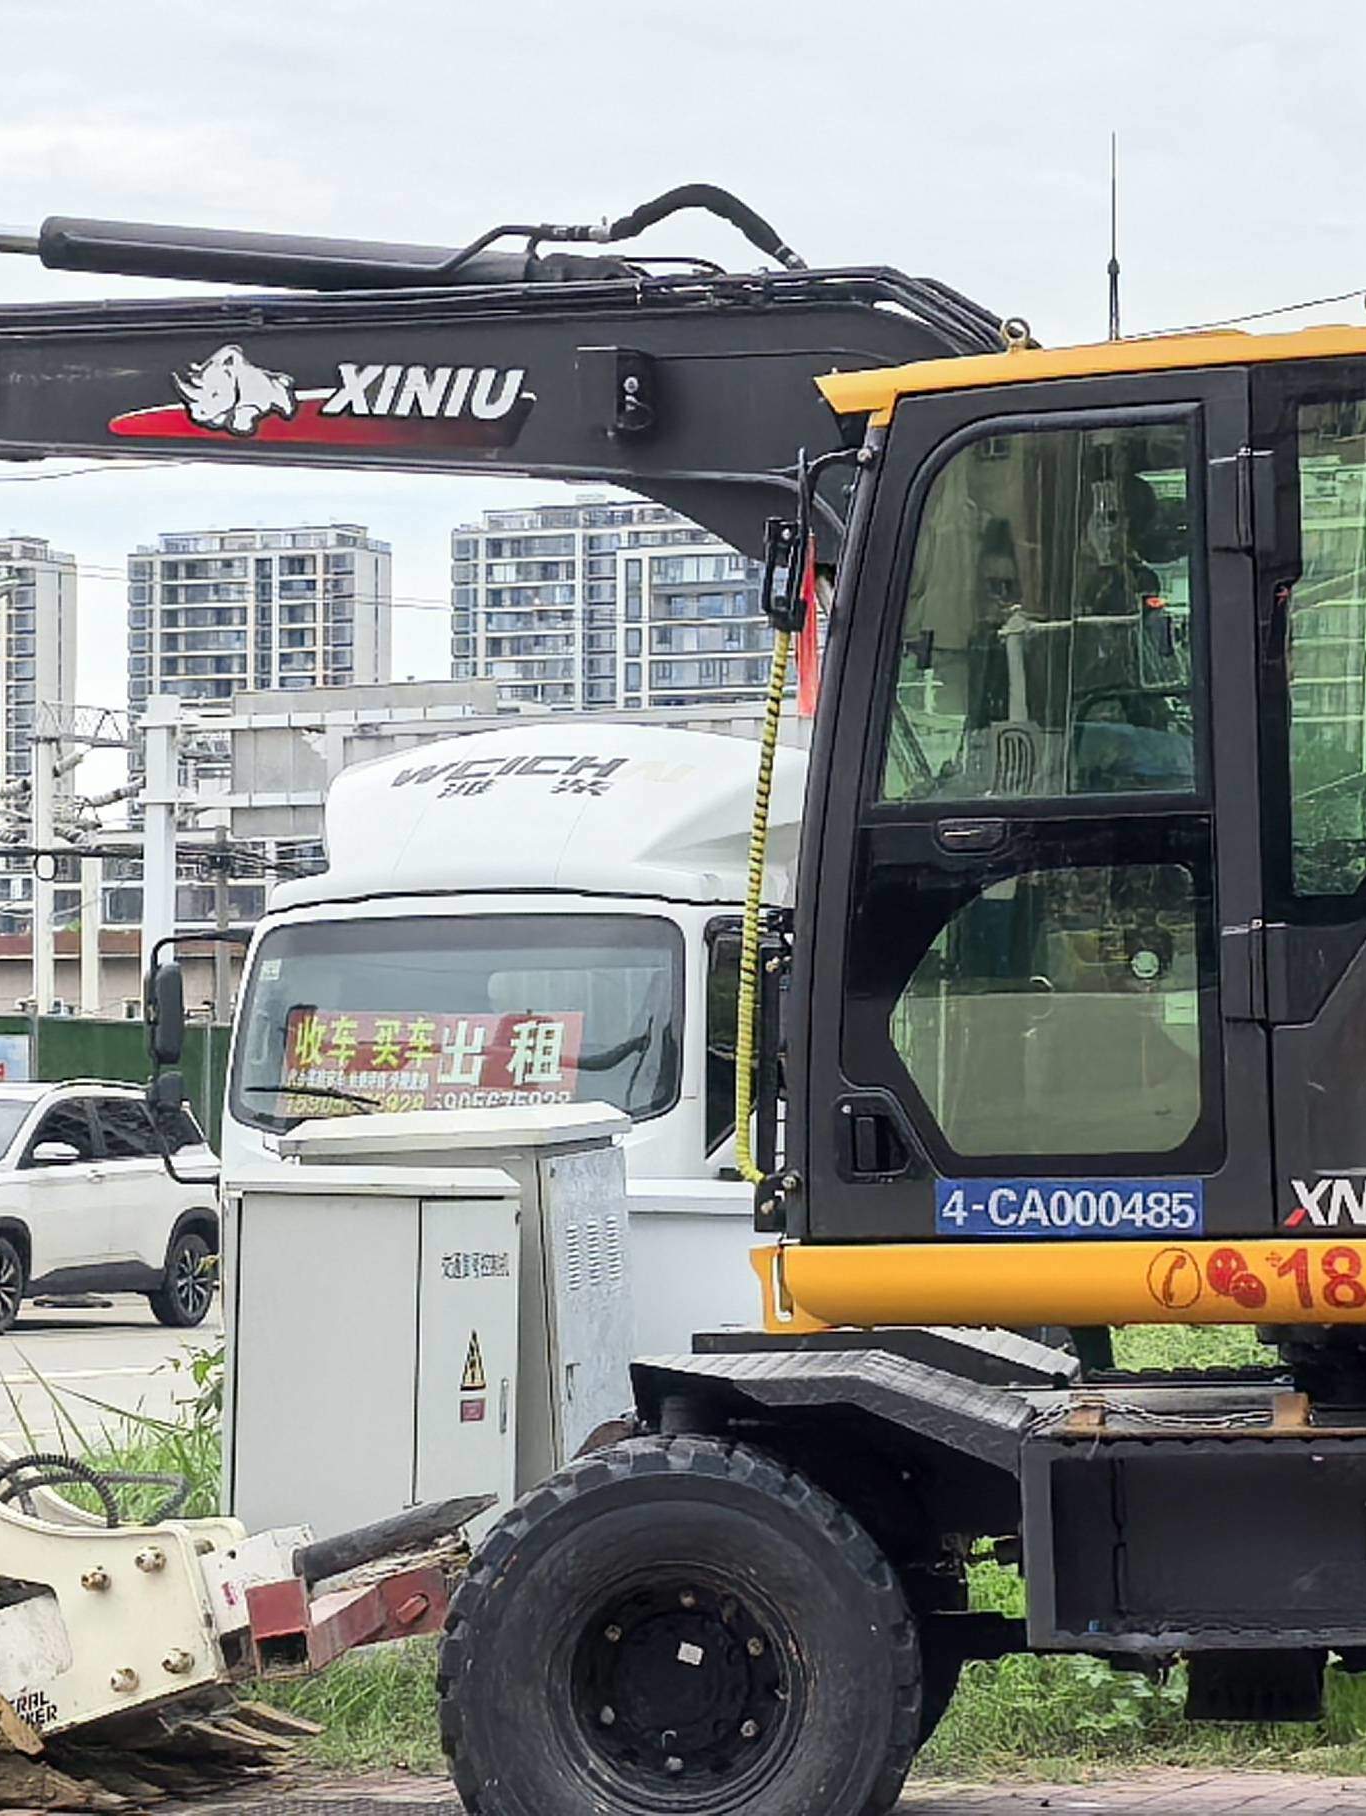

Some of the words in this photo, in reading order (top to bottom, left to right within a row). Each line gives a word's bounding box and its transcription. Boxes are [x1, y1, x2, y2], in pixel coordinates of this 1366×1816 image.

[322, 363, 525, 421] XINIU
[294, 1015, 358, 1066] 收车
[372, 1016, 434, 1068] 买车
[437, 1020, 566, 1086] 出租
[941, 1188, 1196, 1229] 4-CA000485
[9, 1690, 50, 1713] RAL
[19, 1704, 58, 1729] KER
